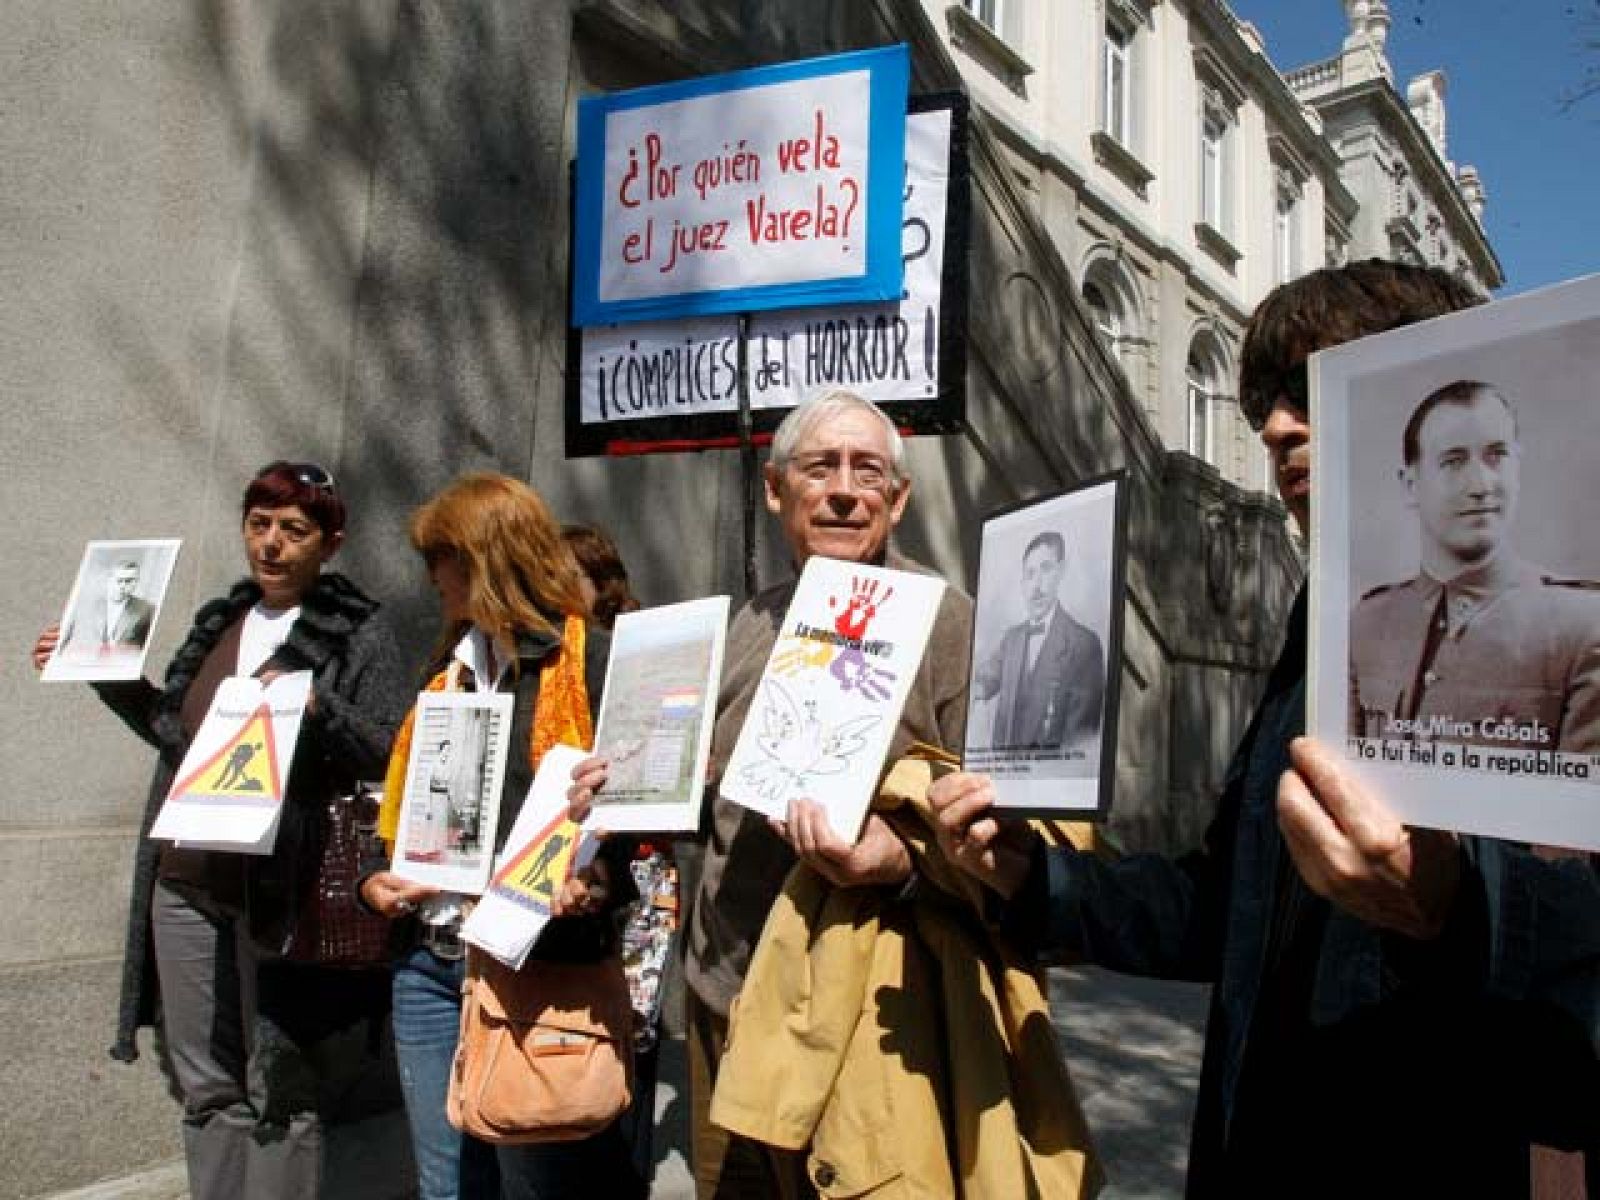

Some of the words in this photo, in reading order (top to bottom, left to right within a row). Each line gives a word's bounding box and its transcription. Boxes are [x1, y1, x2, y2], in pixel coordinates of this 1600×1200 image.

[619, 132, 681, 208] ¿Por
[695, 139, 760, 200] quién
[777, 109, 841, 173] vela
[622, 218, 653, 263] el
[659, 219, 730, 273] juez
[747, 177, 858, 252] Varela?
[755, 331, 789, 392] del
[1382, 738, 1403, 761] fui
[1442, 751, 1456, 767] a
[1462, 742, 1480, 769] la
[1481, 716, 1551, 744] Casals
